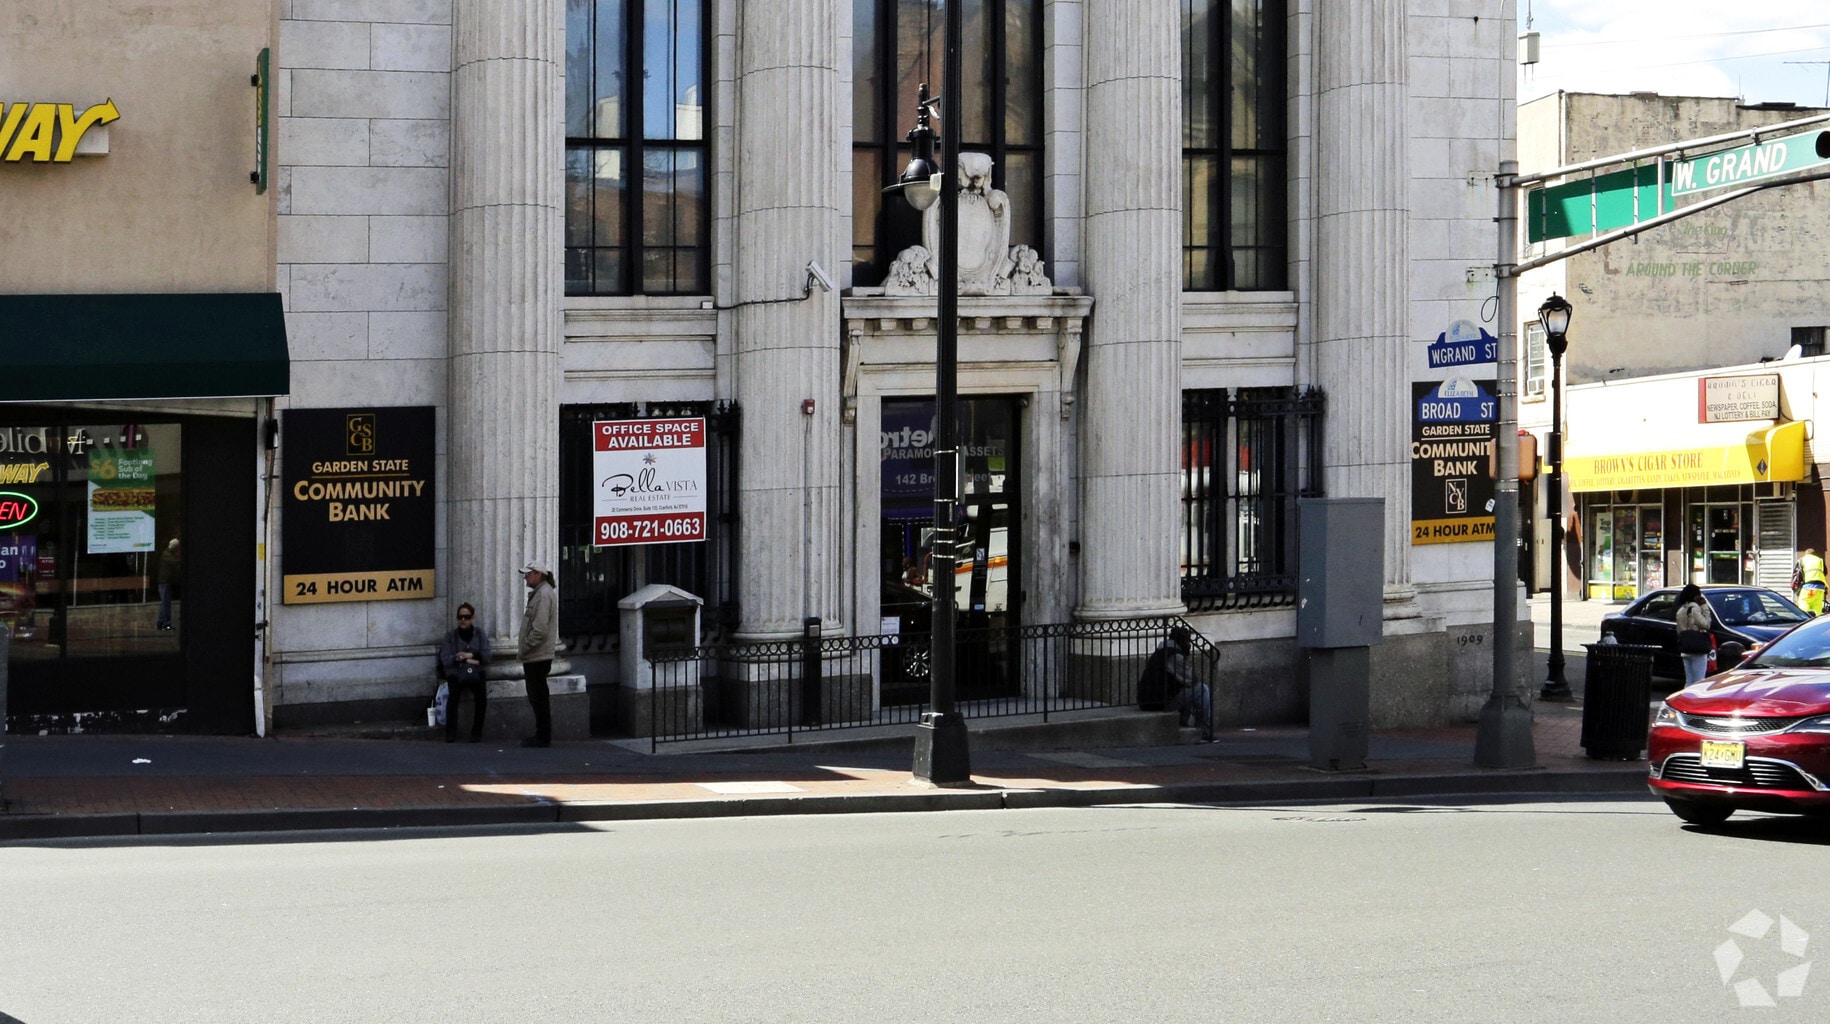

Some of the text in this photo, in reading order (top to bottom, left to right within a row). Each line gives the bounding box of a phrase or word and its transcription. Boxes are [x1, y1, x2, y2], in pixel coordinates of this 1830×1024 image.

[1676, 142, 1788, 191] W. GRAND
[1626, 261, 1760, 277] AROUND THE CORNER
[1485, 342, 1497, 359] ST
[1421, 402, 1494, 419] BROAD ST
[1721, 411, 1744, 419] LOTTERY
[1761, 409, 1771, 417] PAY
[602, 422, 699, 435] OFFICE SPACE
[1422, 424, 1491, 436] GARDEN STATE
[608, 433, 692, 449] AVAILABLE
[884, 445, 1005, 460] PARAMO ASSETS
[1411, 441, 1491, 459] COMMUNIT
[90, 458, 153, 480] $6 Footlong
[134, 465, 143, 473] of
[312, 459, 409, 474] GARDEN STATE
[1433, 459, 1478, 476] BANK
[1594, 452, 1704, 475] BROWN'S CIGAR STORE
[132, 472, 148, 480] Day
[601, 467, 698, 498] Bella VISTA
[895, 474, 917, 485] 142
[293, 480, 426, 501] COMMUNITY
[630, 494, 646, 502] REAL
[328, 501, 391, 522] BANK
[600, 517, 701, 540] 908-721-0663
[1415, 522, 1495, 539] 24 HOUR ATM
[296, 576, 423, 596] 24 HOUR ATM
[1457, 635, 1483, 647] 1909
